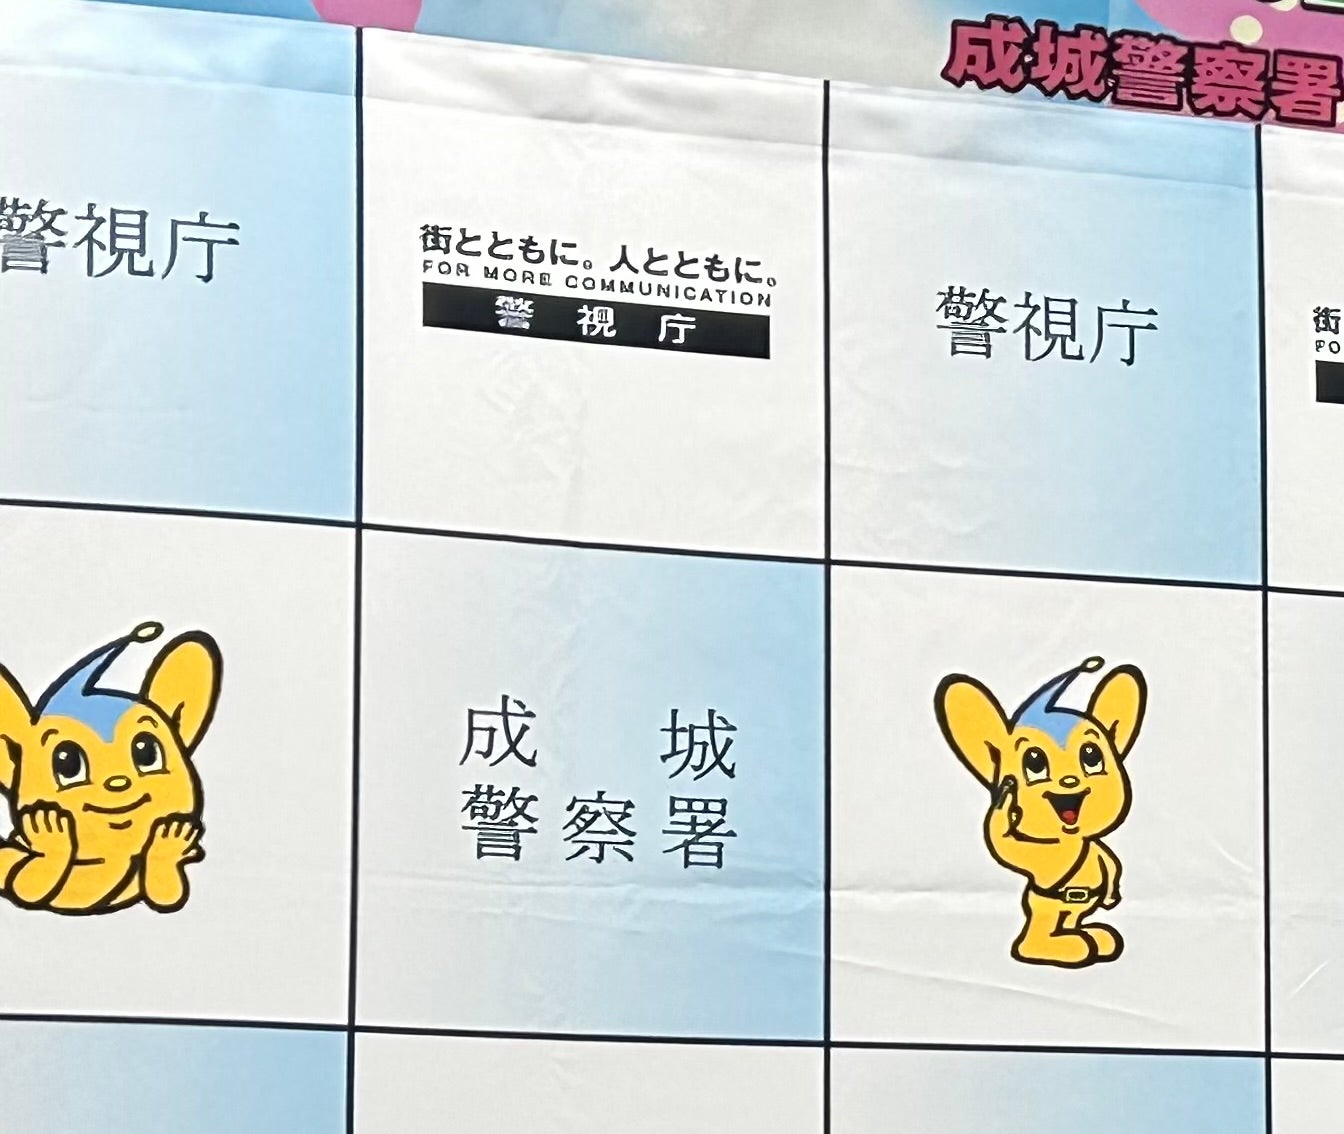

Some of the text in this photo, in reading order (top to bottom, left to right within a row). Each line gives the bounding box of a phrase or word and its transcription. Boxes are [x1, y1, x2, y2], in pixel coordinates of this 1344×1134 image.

[0, 197, 240, 283] 警視庁
[420, 224, 776, 286] 街とともに。人とともに。
[423, 260, 770, 307] FOR MORE COMMUNICATION
[495, 296, 696, 343] 警視庁
[936, 286, 1158, 366] 警視庁
[461, 784, 737, 869] 警察署
